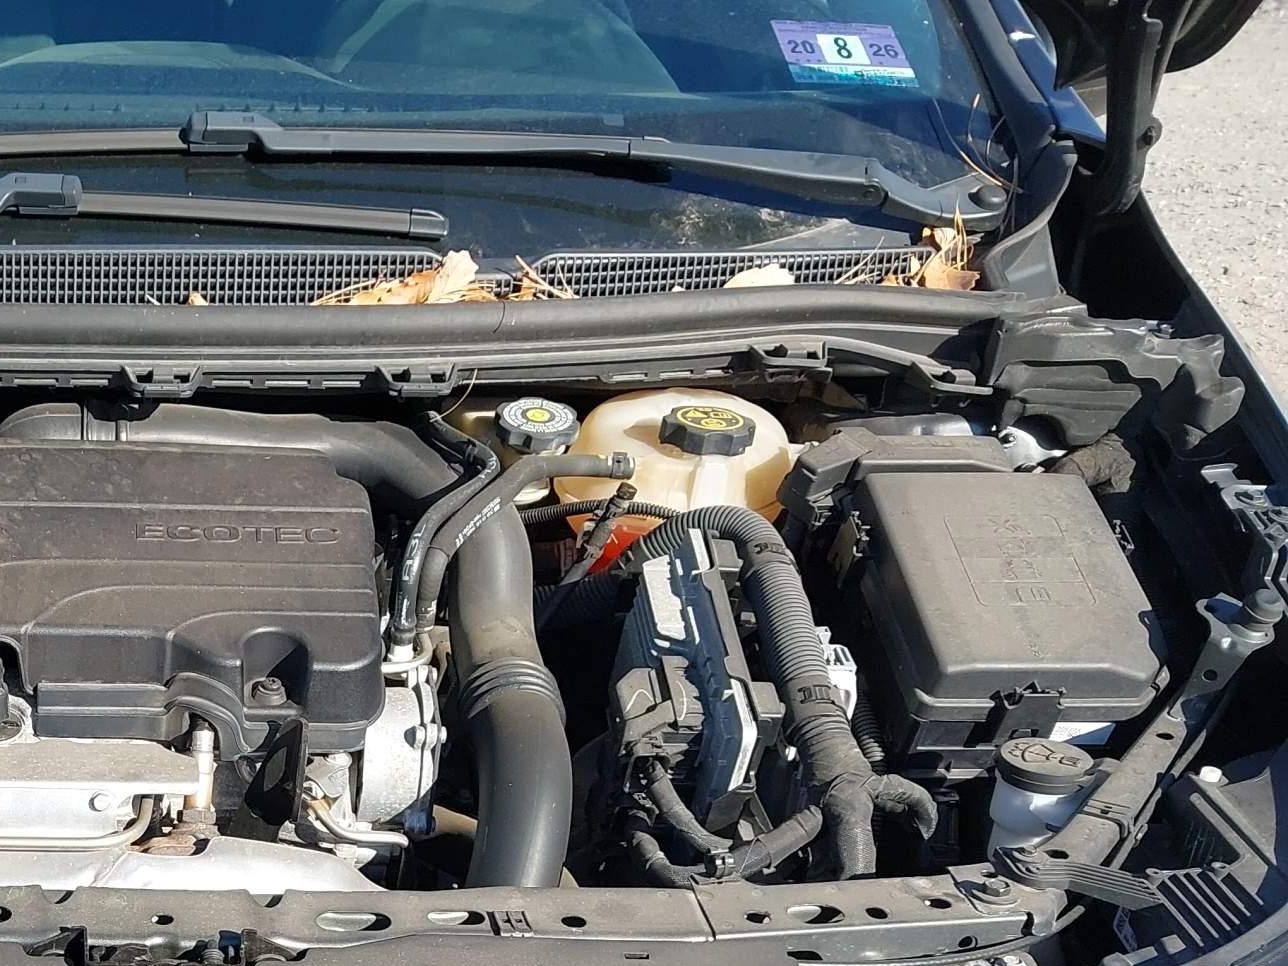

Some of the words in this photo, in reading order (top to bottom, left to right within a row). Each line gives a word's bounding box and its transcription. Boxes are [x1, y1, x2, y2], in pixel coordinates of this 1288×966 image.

[787, 39, 816, 54] 20
[833, 36, 853, 59] 8
[869, 43, 899, 59] 26
[135, 523, 341, 545] ECOTEC
